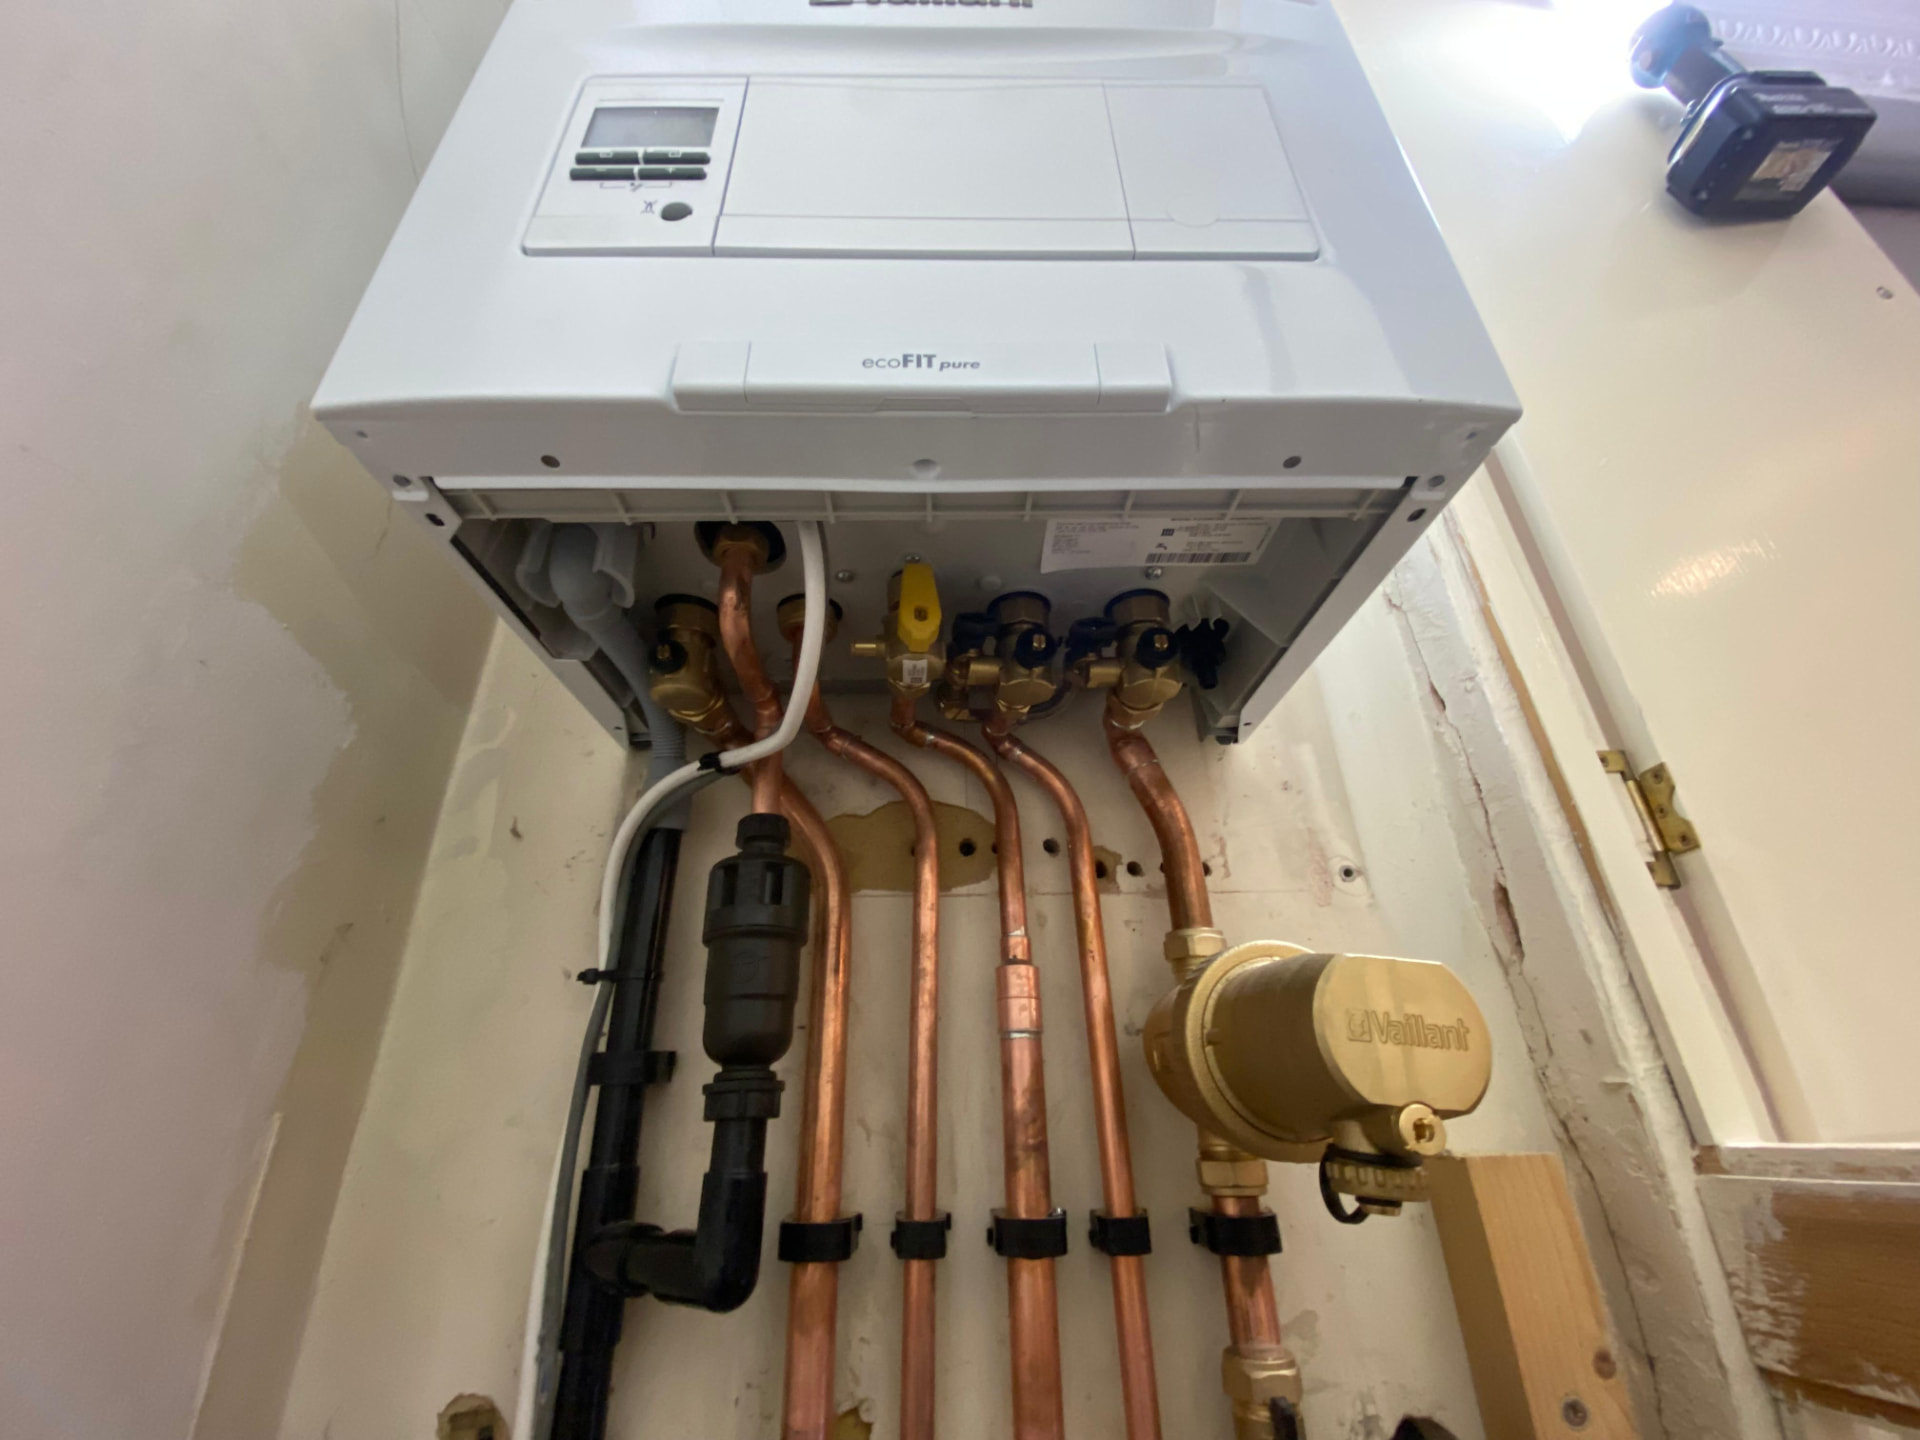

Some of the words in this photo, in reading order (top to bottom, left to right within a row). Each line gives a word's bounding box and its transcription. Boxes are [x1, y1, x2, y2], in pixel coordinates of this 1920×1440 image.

[862, 354, 937, 369] ecoFIT
[939, 361, 981, 372] pure
[1370, 1009, 1470, 1052] Vaillant
